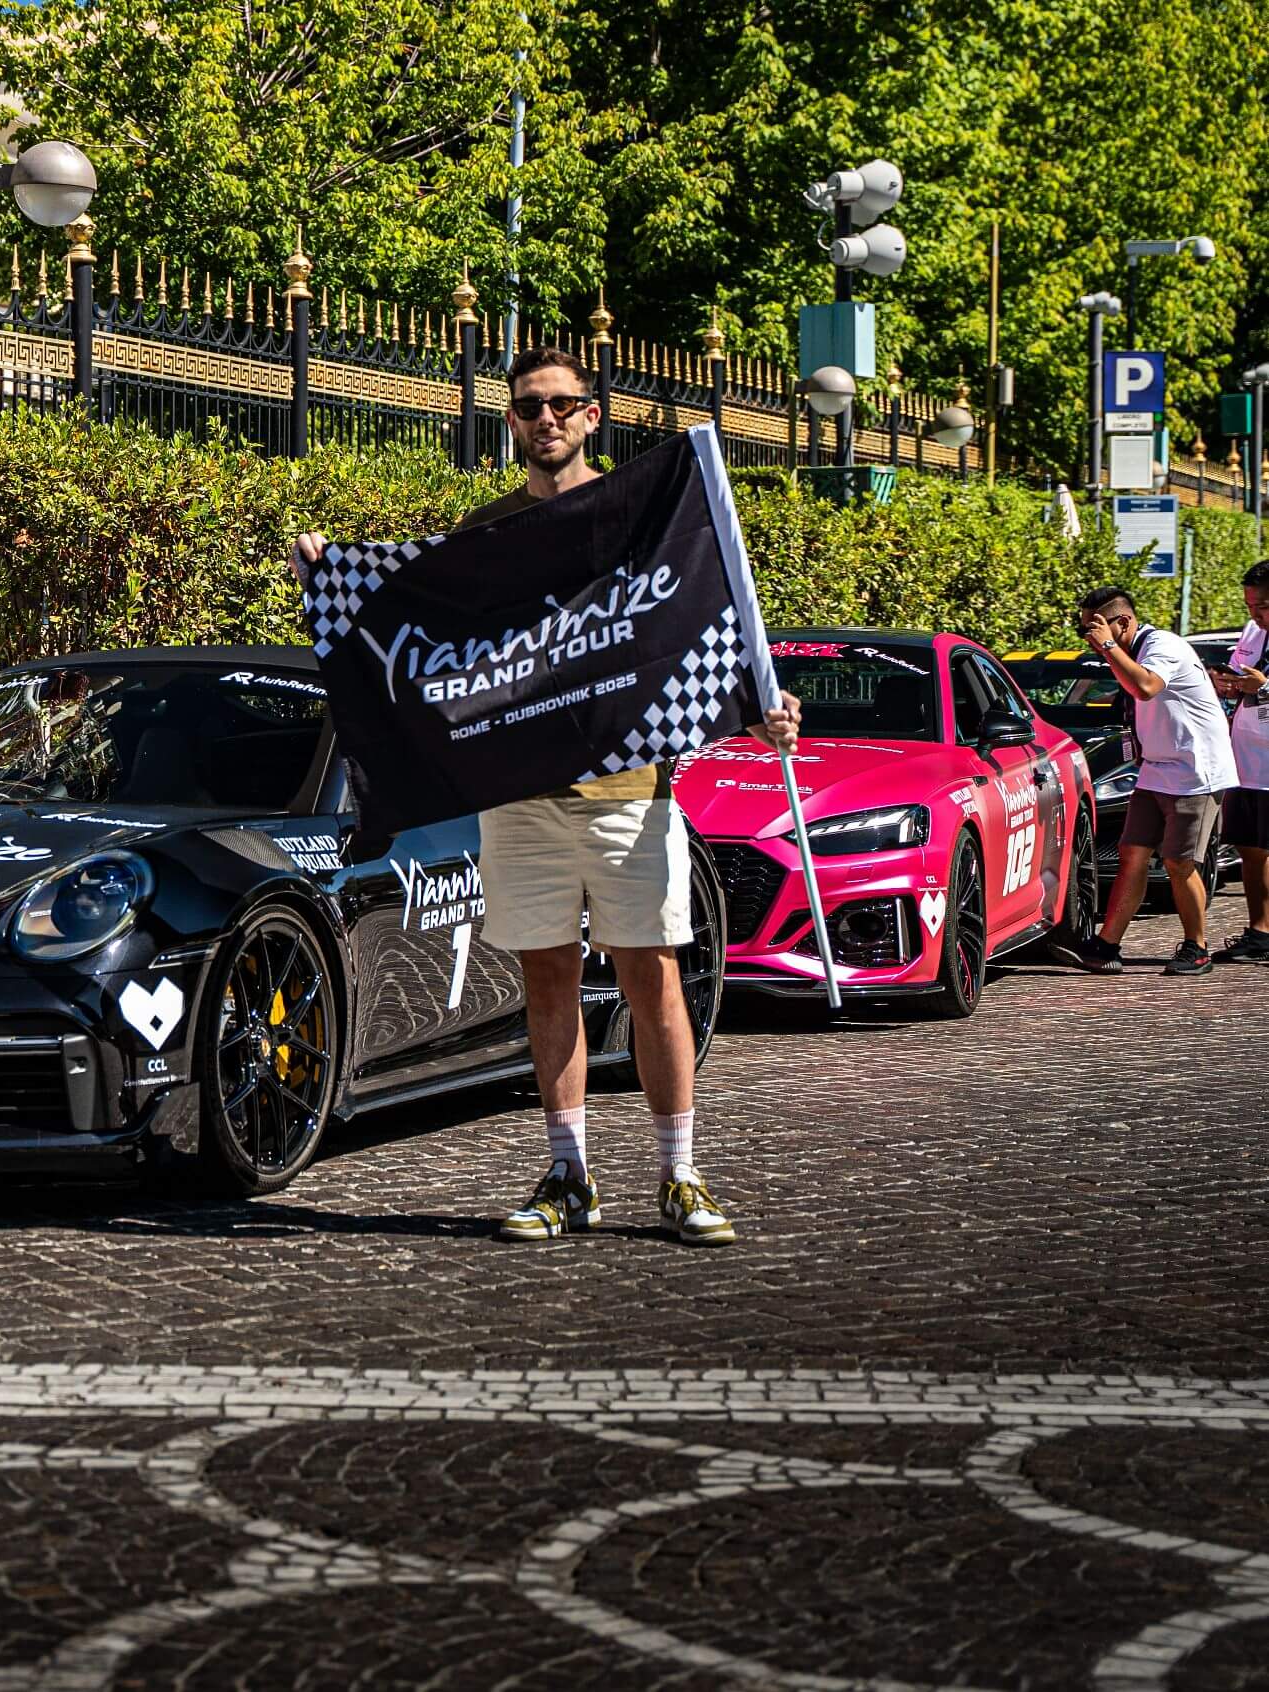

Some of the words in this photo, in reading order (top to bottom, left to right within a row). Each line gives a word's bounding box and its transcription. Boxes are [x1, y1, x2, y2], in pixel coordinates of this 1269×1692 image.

[1115, 357, 1154, 406] P
[358, 564, 681, 704] Yiannimize
[422, 657, 535, 703] GRAND
[548, 619, 635, 665] TOUR
[254, 675, 329, 697] AutoRefun
[450, 720, 491, 742] ROME
[505, 687, 591, 725] DUBROVNIK
[594, 672, 638, 697] 2025
[738, 782, 813, 794] SmarTck
[1002, 823, 1036, 897] 102
[421, 903, 465, 930] GRAND
[448, 922, 472, 1010] 1
[582, 990, 620, 1002] marquees
[147, 1058, 168, 1073] CCL
